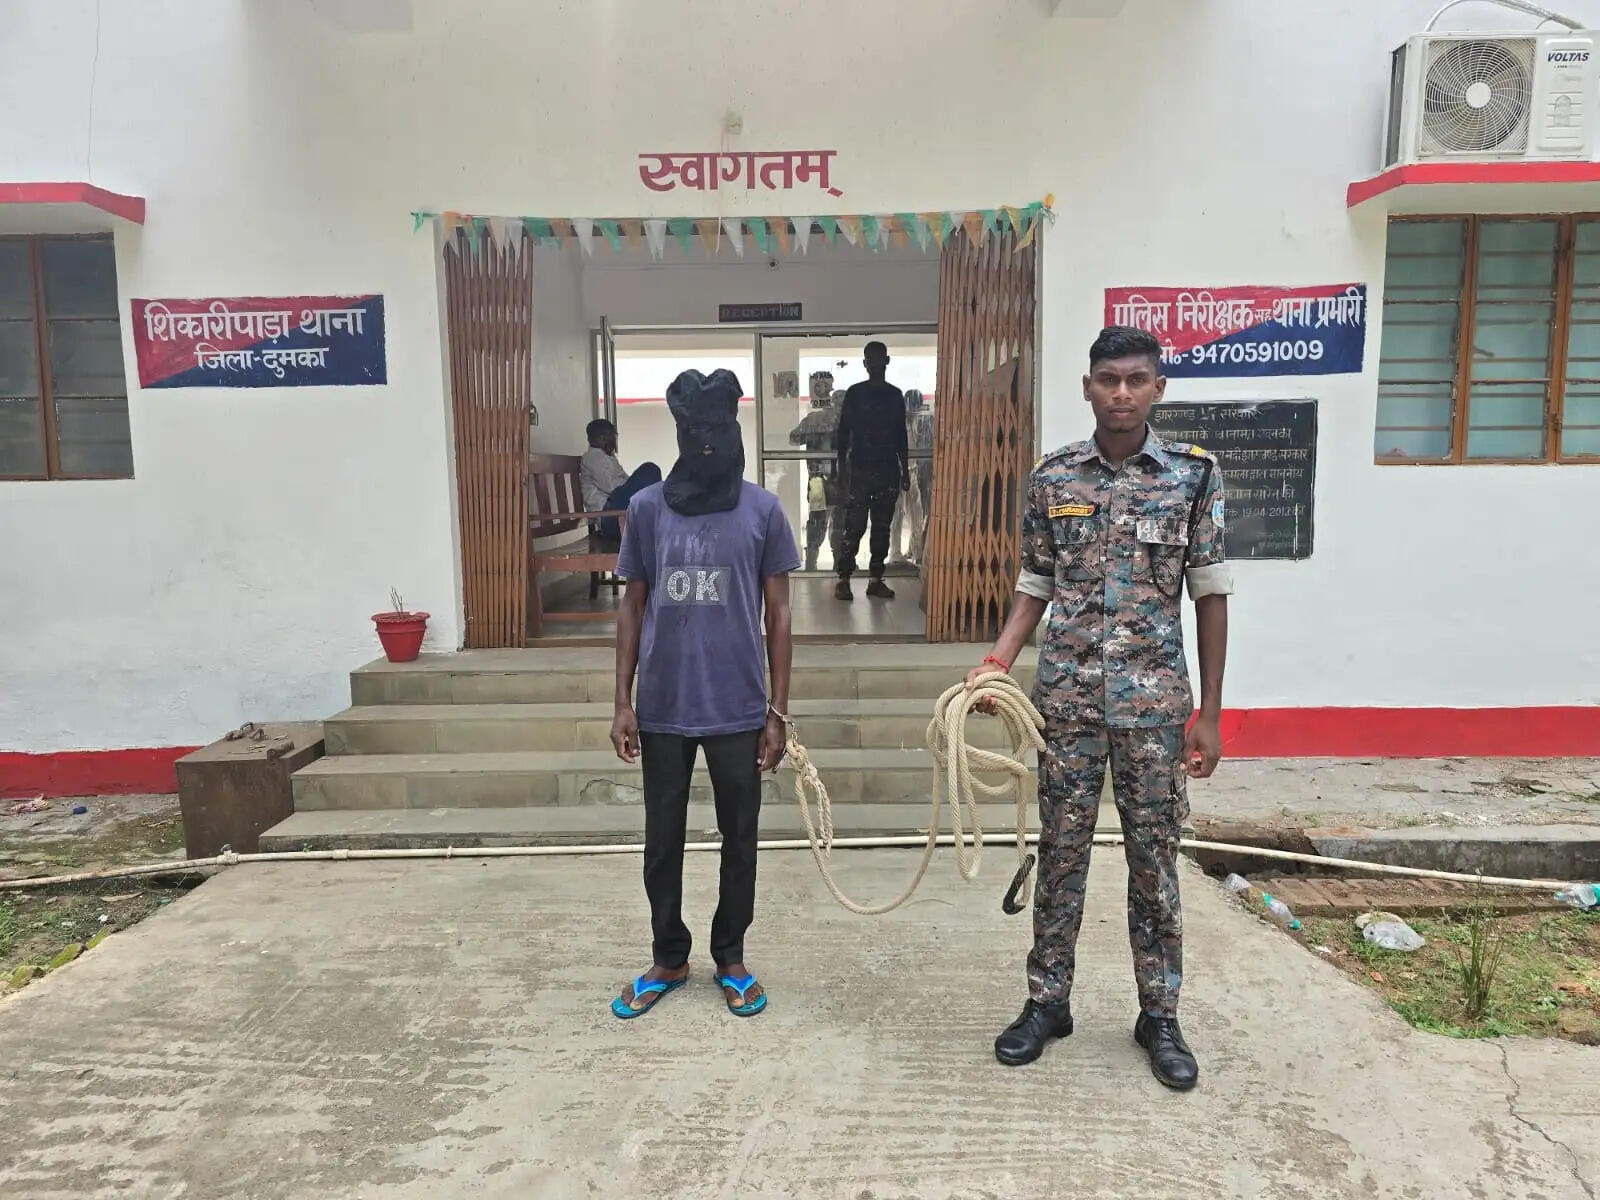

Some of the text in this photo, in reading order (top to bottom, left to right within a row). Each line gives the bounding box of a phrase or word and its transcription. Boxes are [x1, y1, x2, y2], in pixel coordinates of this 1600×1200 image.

[1547, 52, 1590, 62] VOLTAS
[639, 151, 843, 197] स्वागतम्
[144, 301, 367, 344] शिकारीपाड़ा थाना
[1112, 294, 1172, 334] पलिस
[1176, 291, 1255, 334] निरीक्षक
[1272, 298, 1316, 328] थाना
[1315, 286, 1364, 328] प्रभारी
[194, 342, 329, 378] जिला-दुमका
[667, 570, 721, 602] OK
